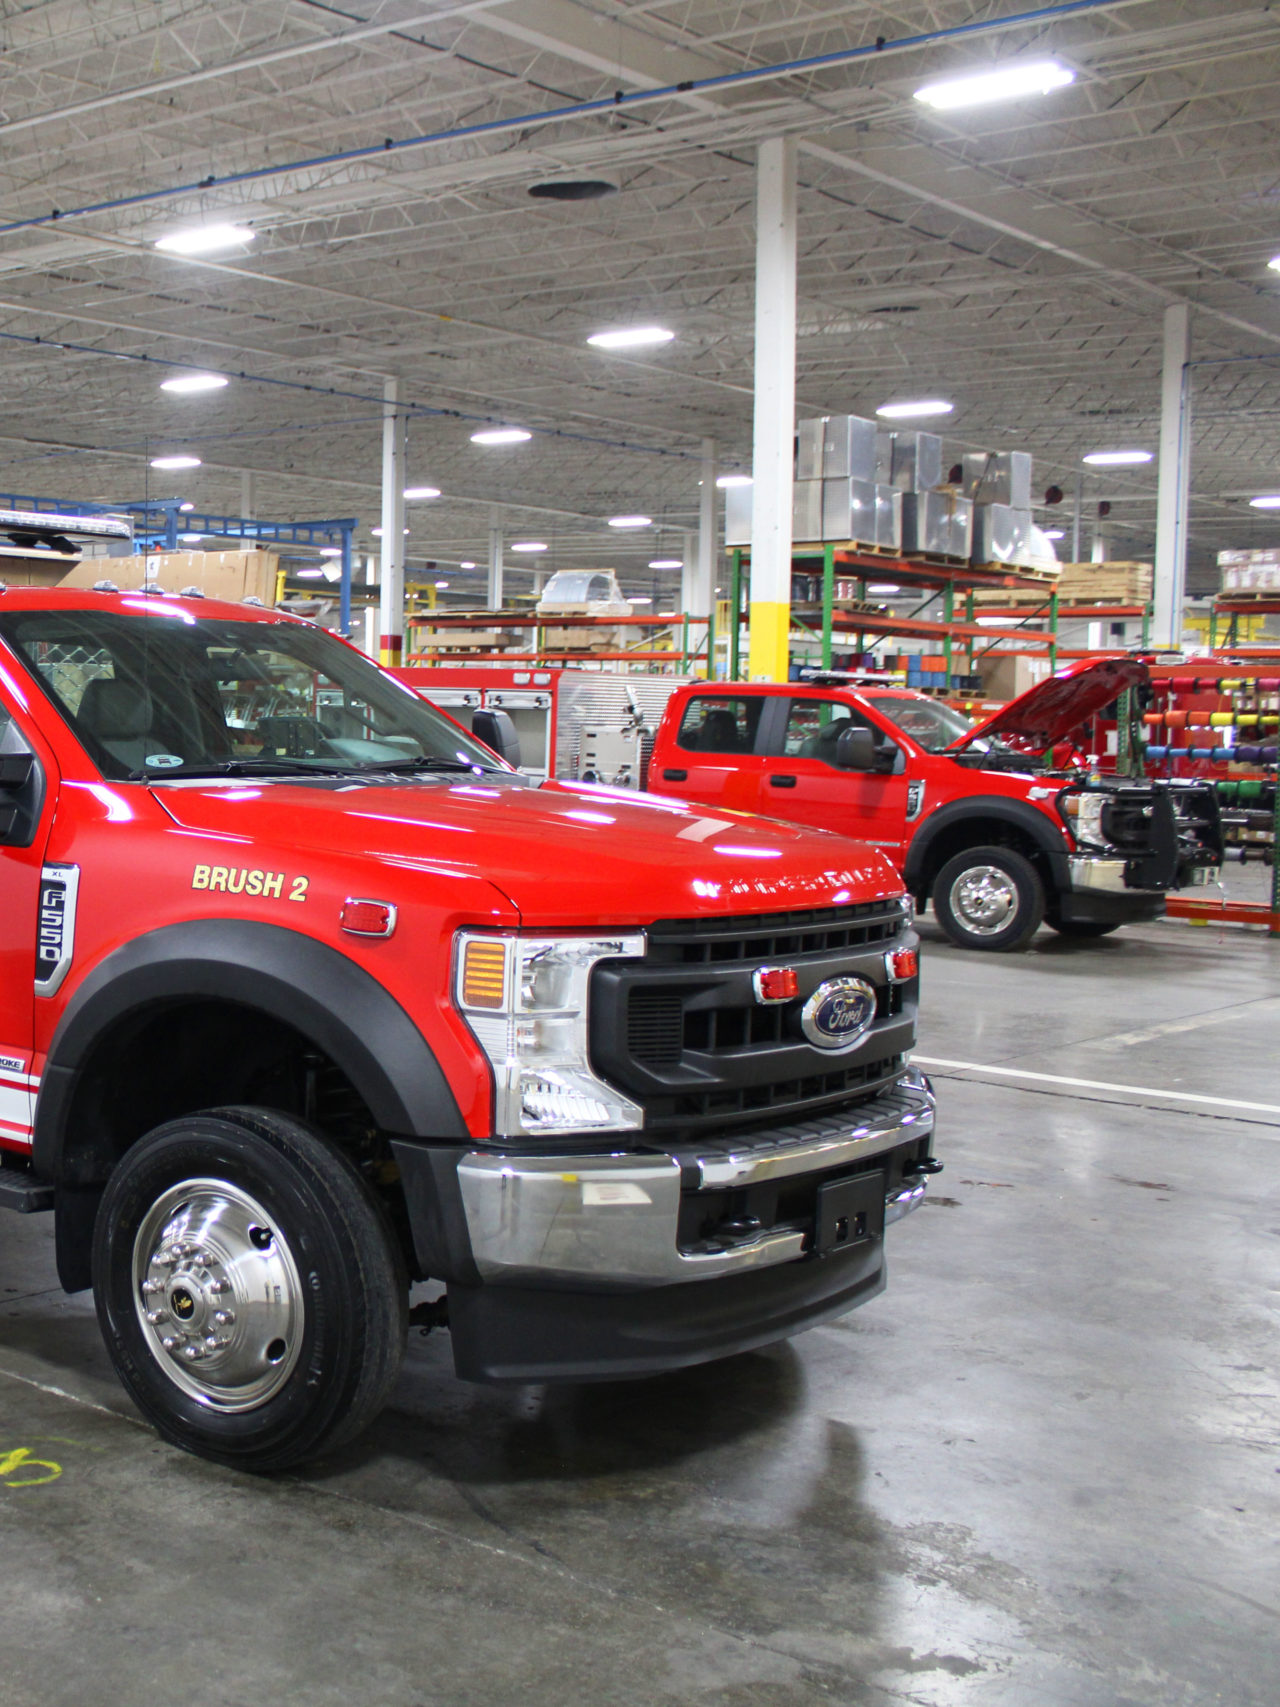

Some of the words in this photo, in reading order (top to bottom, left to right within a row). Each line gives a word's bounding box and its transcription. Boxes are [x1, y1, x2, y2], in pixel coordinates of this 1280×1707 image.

[192, 864, 286, 899] BRUSH
[288, 875, 310, 902] 2
[828, 998, 864, 1030] Ford
